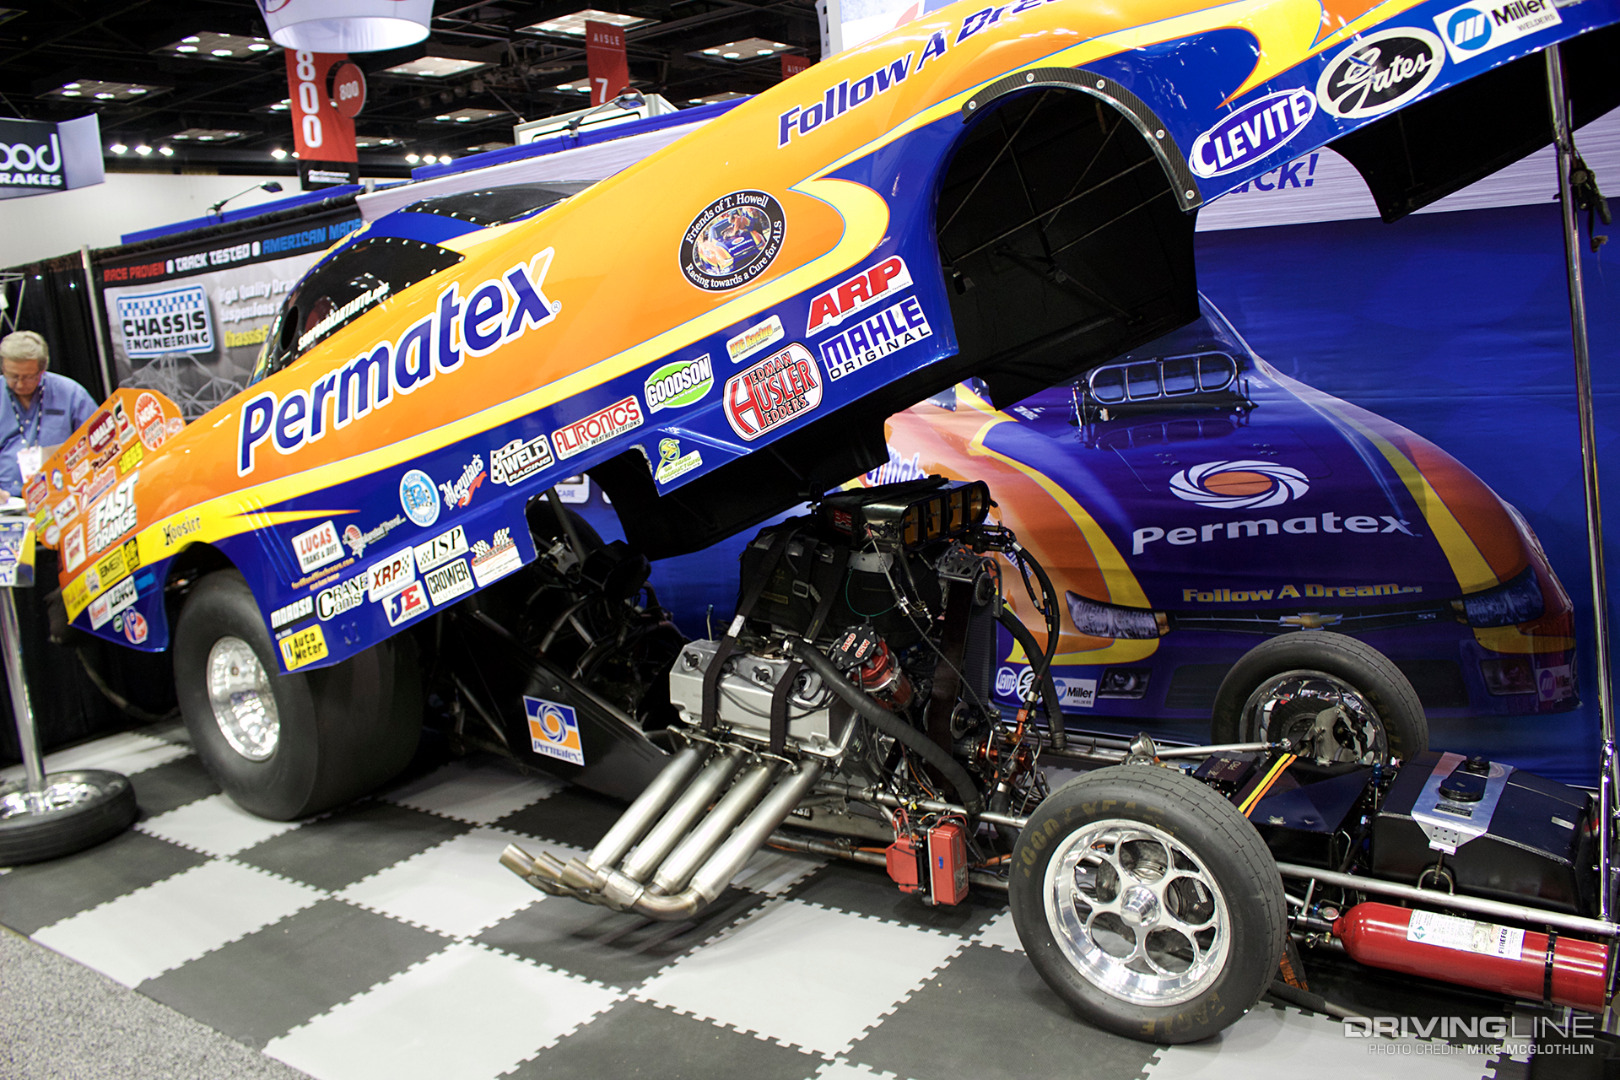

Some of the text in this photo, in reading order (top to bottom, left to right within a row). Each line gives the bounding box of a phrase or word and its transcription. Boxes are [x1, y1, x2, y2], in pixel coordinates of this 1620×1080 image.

[593, 32, 620, 46] AISLE
[339, 80, 360, 100] 800
[595, 78, 608, 103] 7
[779, 52, 913, 147] Follow
[915, 29, 947, 72] A
[1337, 47, 1433, 114] Gates
[296, 50, 323, 148] 800
[1193, 86, 1308, 177] CLEVITE
[1230, 153, 1319, 194] ck!
[686, 193, 769, 244] Friends of T. Howell
[104, 267, 128, 283] RACE
[129, 261, 165, 280] PROVEN
[175, 252, 208, 272] TRACK
[209, 243, 251, 265] TESTED
[262, 227, 327, 255] AMERICAN
[685, 263, 710, 288] Racing
[711, 274, 744, 288] towards
[748, 257, 768, 275] Cure
[765, 243, 777, 259] for
[772, 220, 782, 244] ALS
[240, 279, 271, 300] Quality
[808, 257, 902, 331] ARP
[123, 311, 207, 338] CHASSIS
[820, 297, 925, 370] MAHLE
[126, 331, 209, 351] ENGINEERING
[829, 327, 931, 380] ORIGINAL
[236, 247, 555, 476] Permatex
[646, 356, 711, 408] GOODSON
[555, 400, 640, 454] ALTRONICS
[591, 418, 641, 446] WEATHER STATIONS
[502, 440, 548, 475] WELD
[509, 455, 551, 482] RACING
[96, 471, 139, 533] FAST
[94, 503, 137, 553] ORANGE
[163, 515, 202, 546] Hoosier
[300, 528, 332, 555] LUCAS
[430, 528, 461, 560] ISP
[1132, 511, 1414, 556] Permatex
[373, 560, 401, 590] XRP
[427, 561, 470, 595] CROWER
[433, 582, 472, 604] CLUTCHES
[1183, 589, 1275, 602] Follow
[1277, 584, 1301, 600] A
[293, 631, 316, 649] Auto
[294, 641, 324, 661] Meter
[841, 633, 857, 653] MSD
[854, 638, 871, 659] MSD
[1067, 686, 1094, 699] Miller
[533, 740, 579, 762] Permatex
